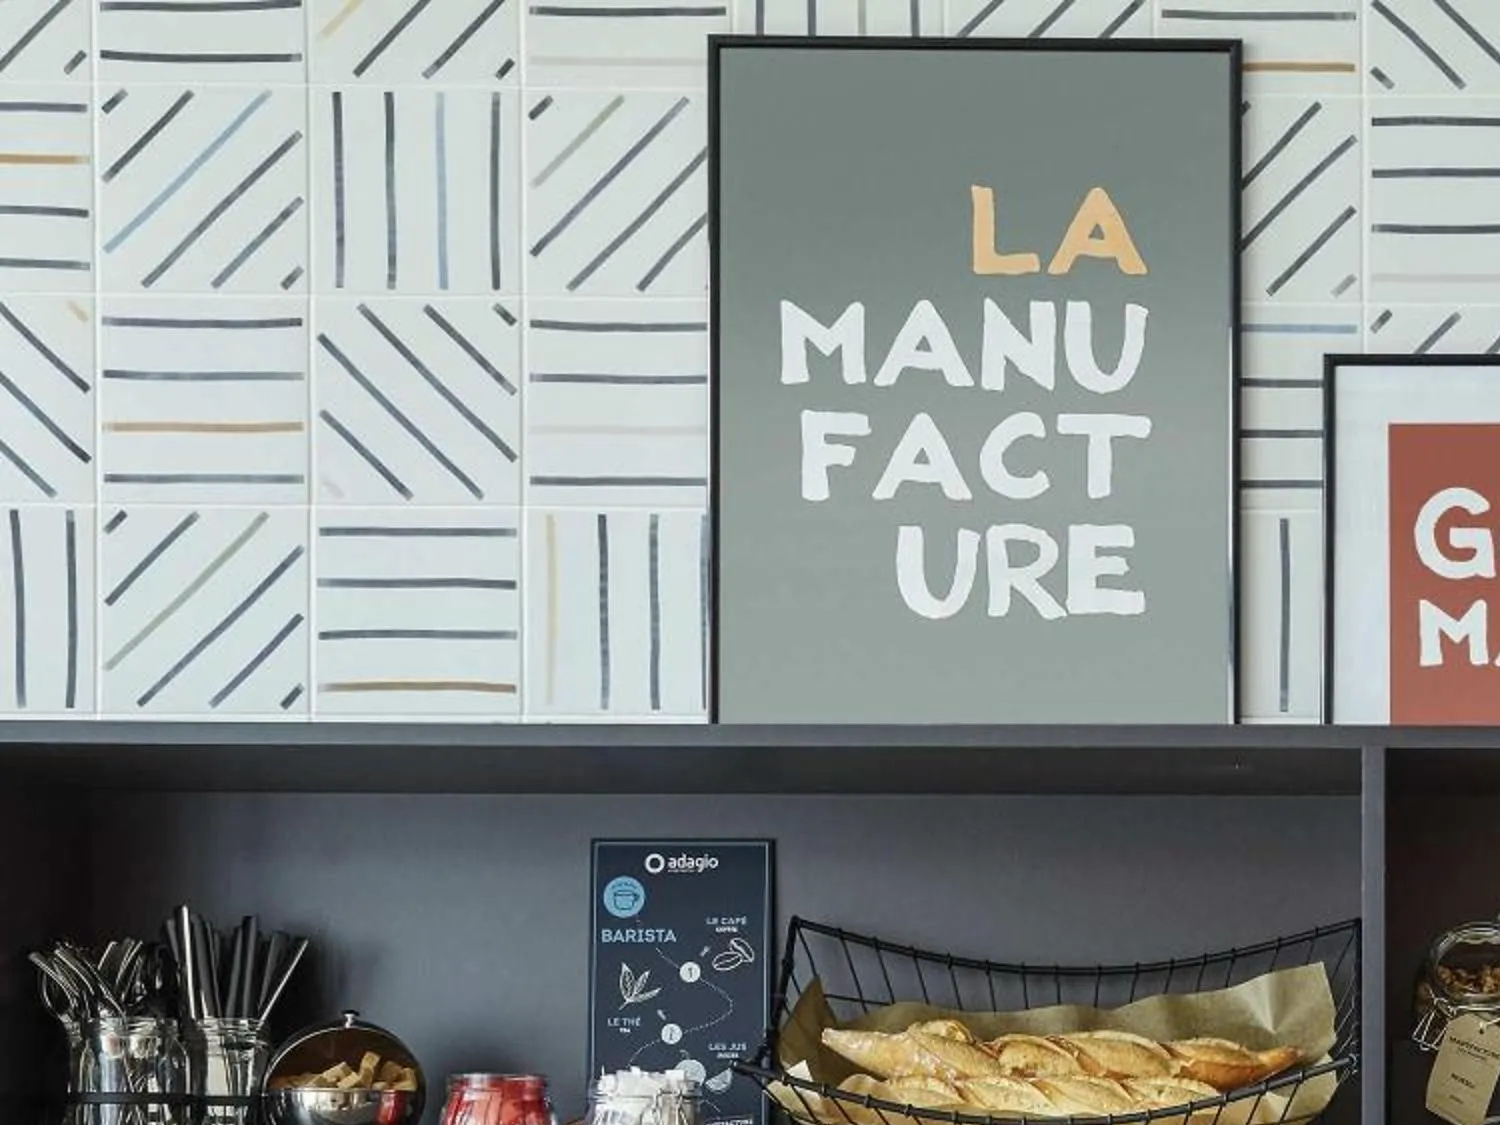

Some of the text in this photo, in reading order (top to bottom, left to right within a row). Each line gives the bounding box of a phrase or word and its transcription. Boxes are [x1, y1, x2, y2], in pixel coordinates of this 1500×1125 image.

[971, 184, 1149, 275] LA
[780, 297, 1149, 394] MANU
[800, 410, 1152, 501] FACT
[896, 523, 1146, 619] URE
[667, 853, 719, 872] adagio
[601, 928, 677, 943] BARISTA
